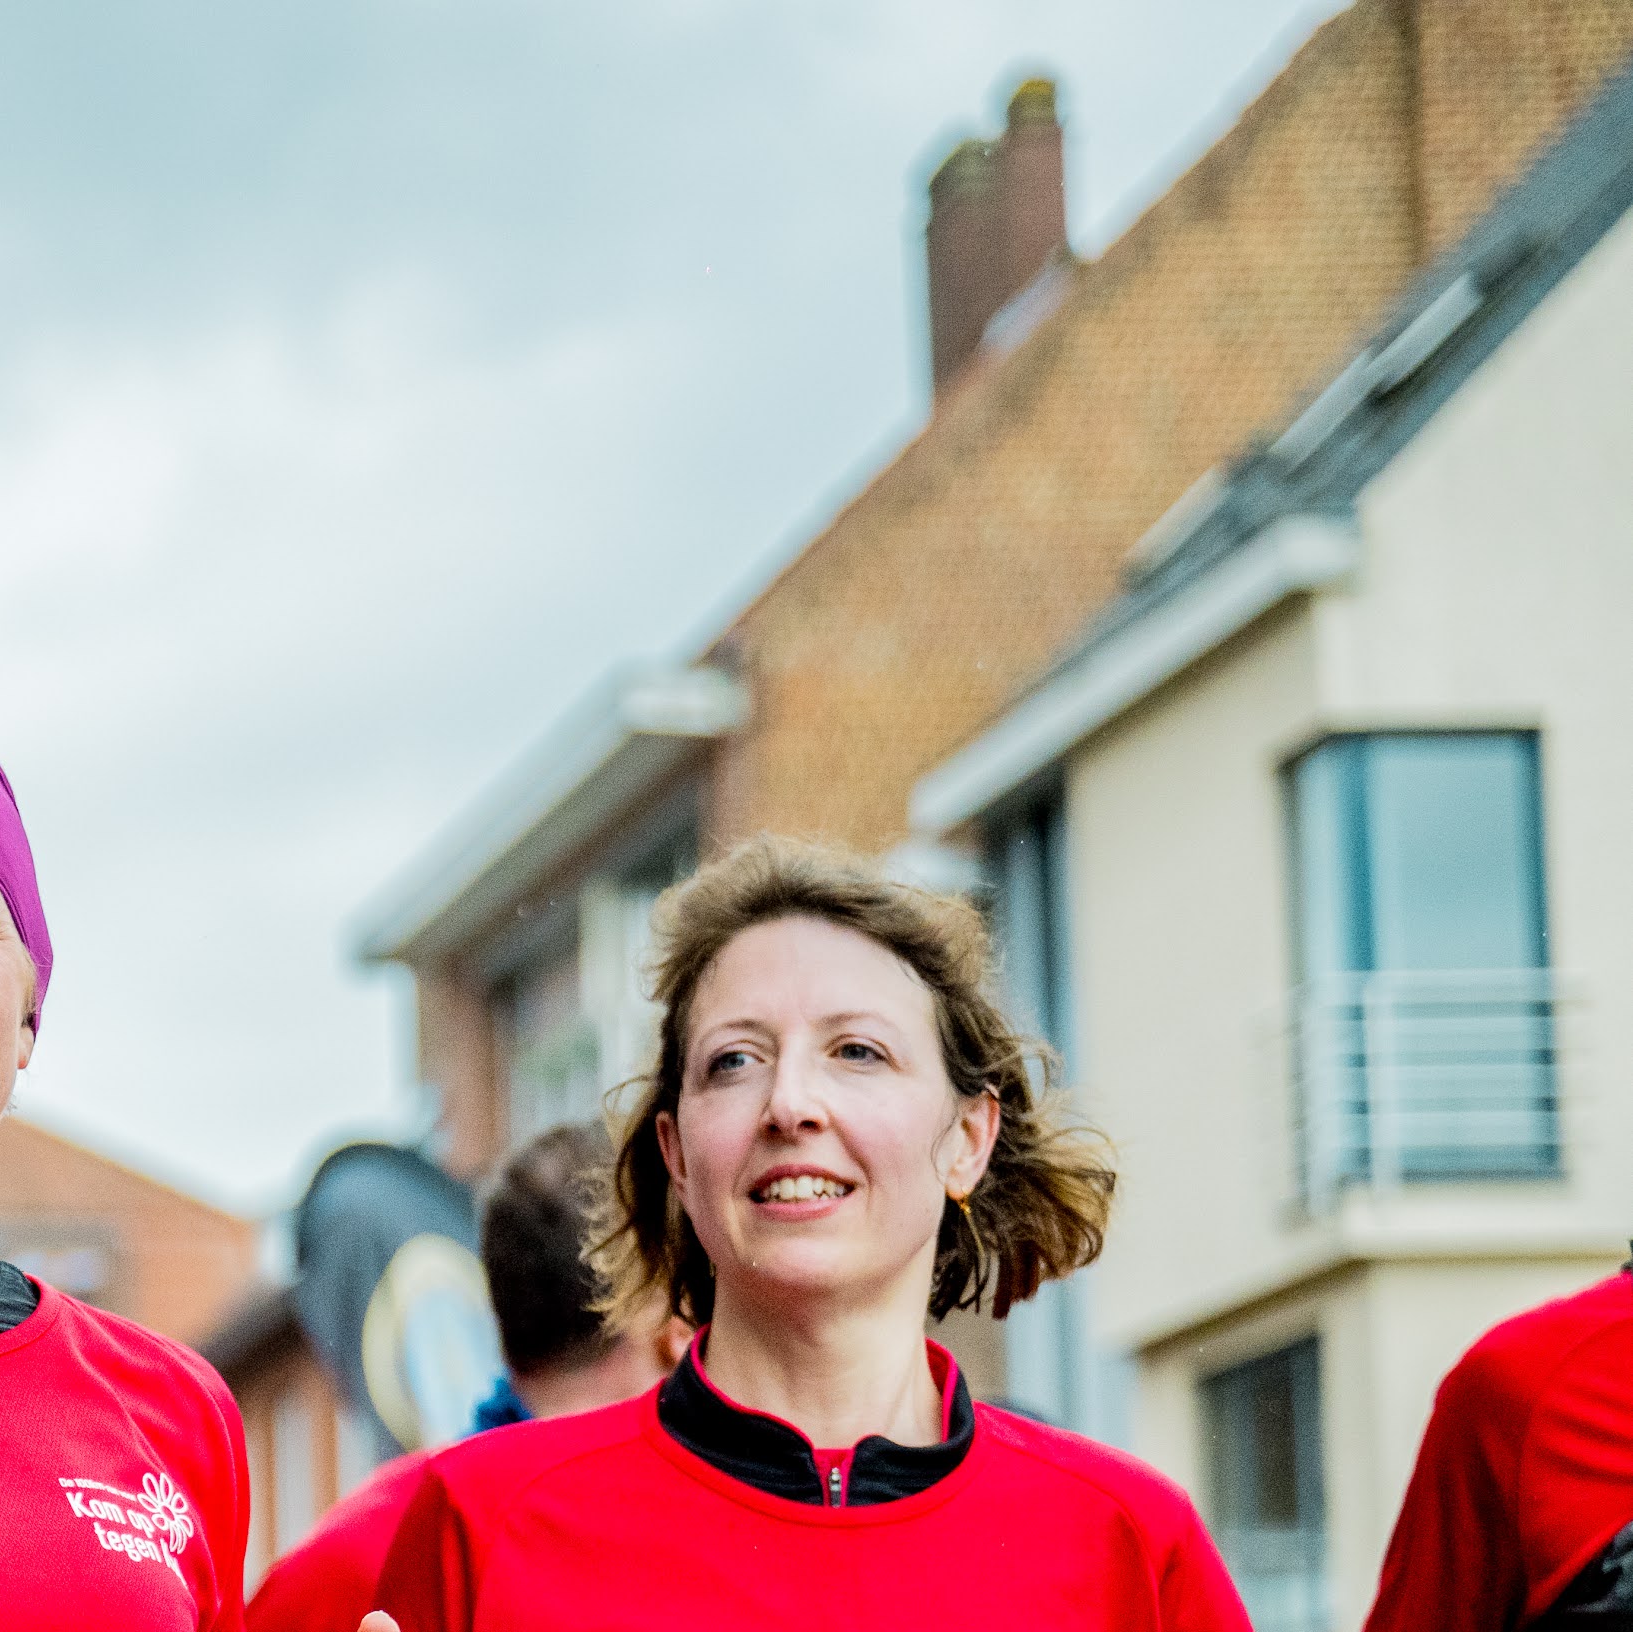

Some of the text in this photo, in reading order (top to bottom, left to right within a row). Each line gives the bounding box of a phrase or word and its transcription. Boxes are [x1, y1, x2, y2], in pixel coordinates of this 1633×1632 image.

[66, 1492, 155, 1538] Kom op
[93, 1521, 163, 1562] tegen
